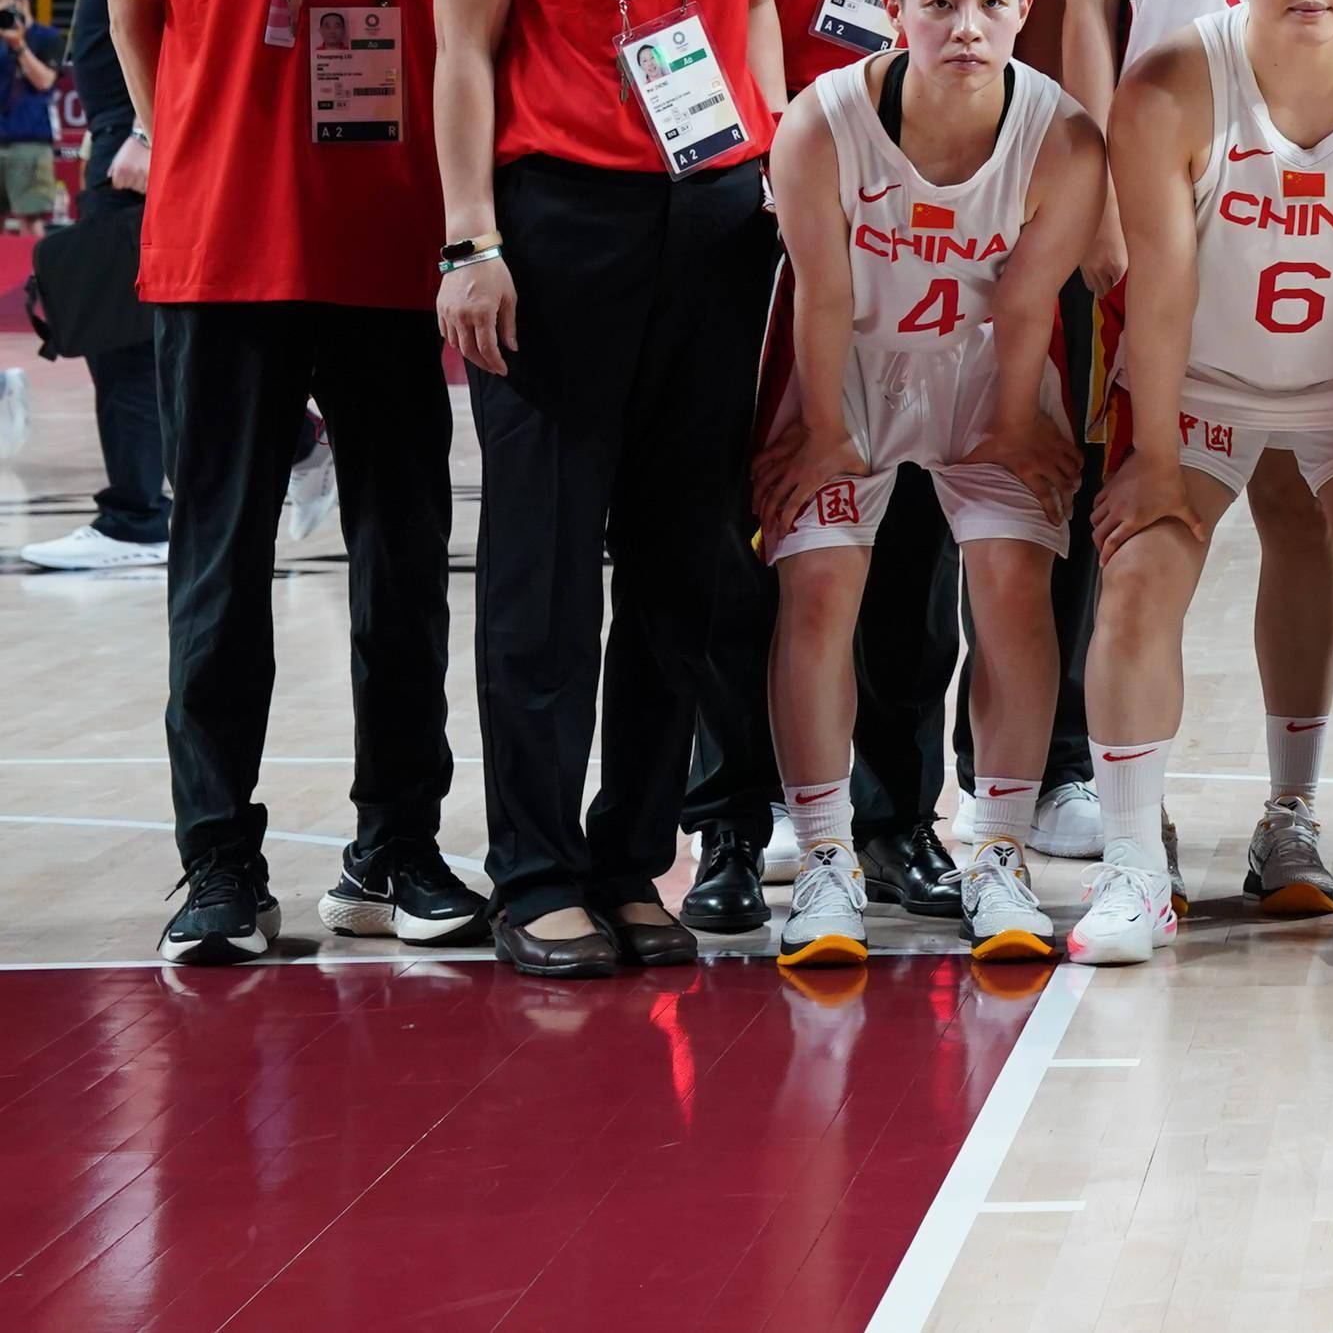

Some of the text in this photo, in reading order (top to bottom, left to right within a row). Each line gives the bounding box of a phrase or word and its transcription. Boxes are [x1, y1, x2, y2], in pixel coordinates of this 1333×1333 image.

[824, 20, 832, 31] A
[836, 24, 844, 35] 2
[322, 126, 396, 137] A 2 R
[679, 129, 741, 165] A 2 R
[855, 223, 1008, 265] CHINA
[897, 278, 966, 337] 4
[1256, 262, 1331, 334] 6
